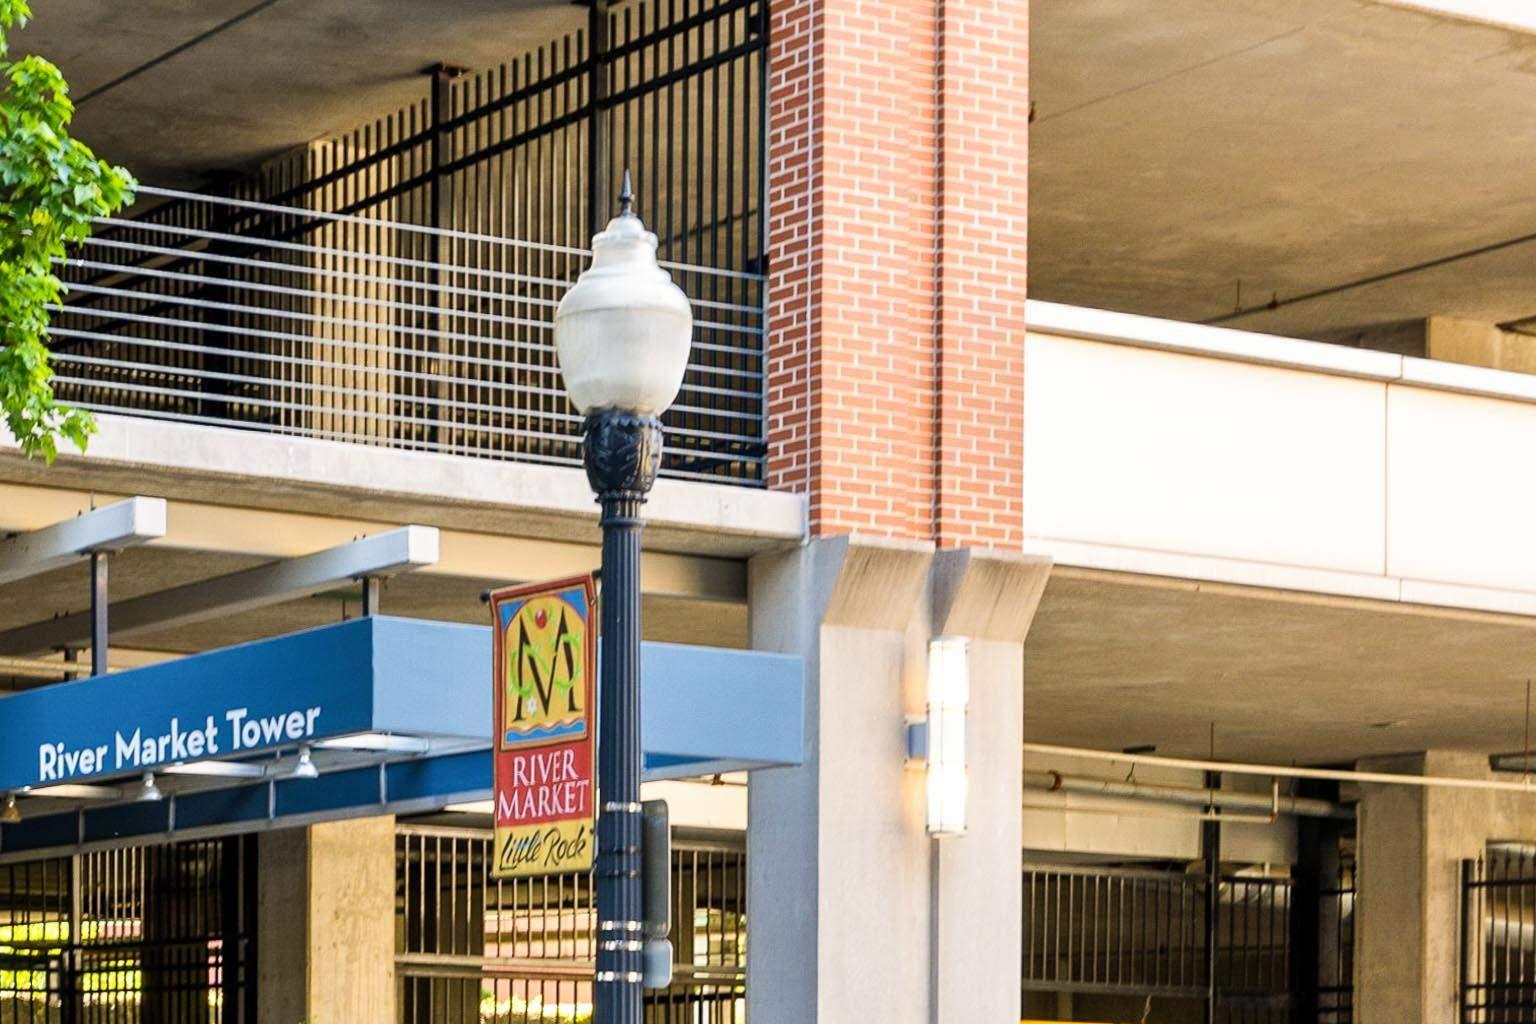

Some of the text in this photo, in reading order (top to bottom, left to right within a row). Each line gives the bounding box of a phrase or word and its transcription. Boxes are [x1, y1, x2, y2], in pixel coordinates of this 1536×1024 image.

[39, 706, 322, 782] River Market Tower
[513, 749, 579, 789] RIVER
[497, 778, 590, 821] MARKET
[499, 826, 587, 872] Little Rock
